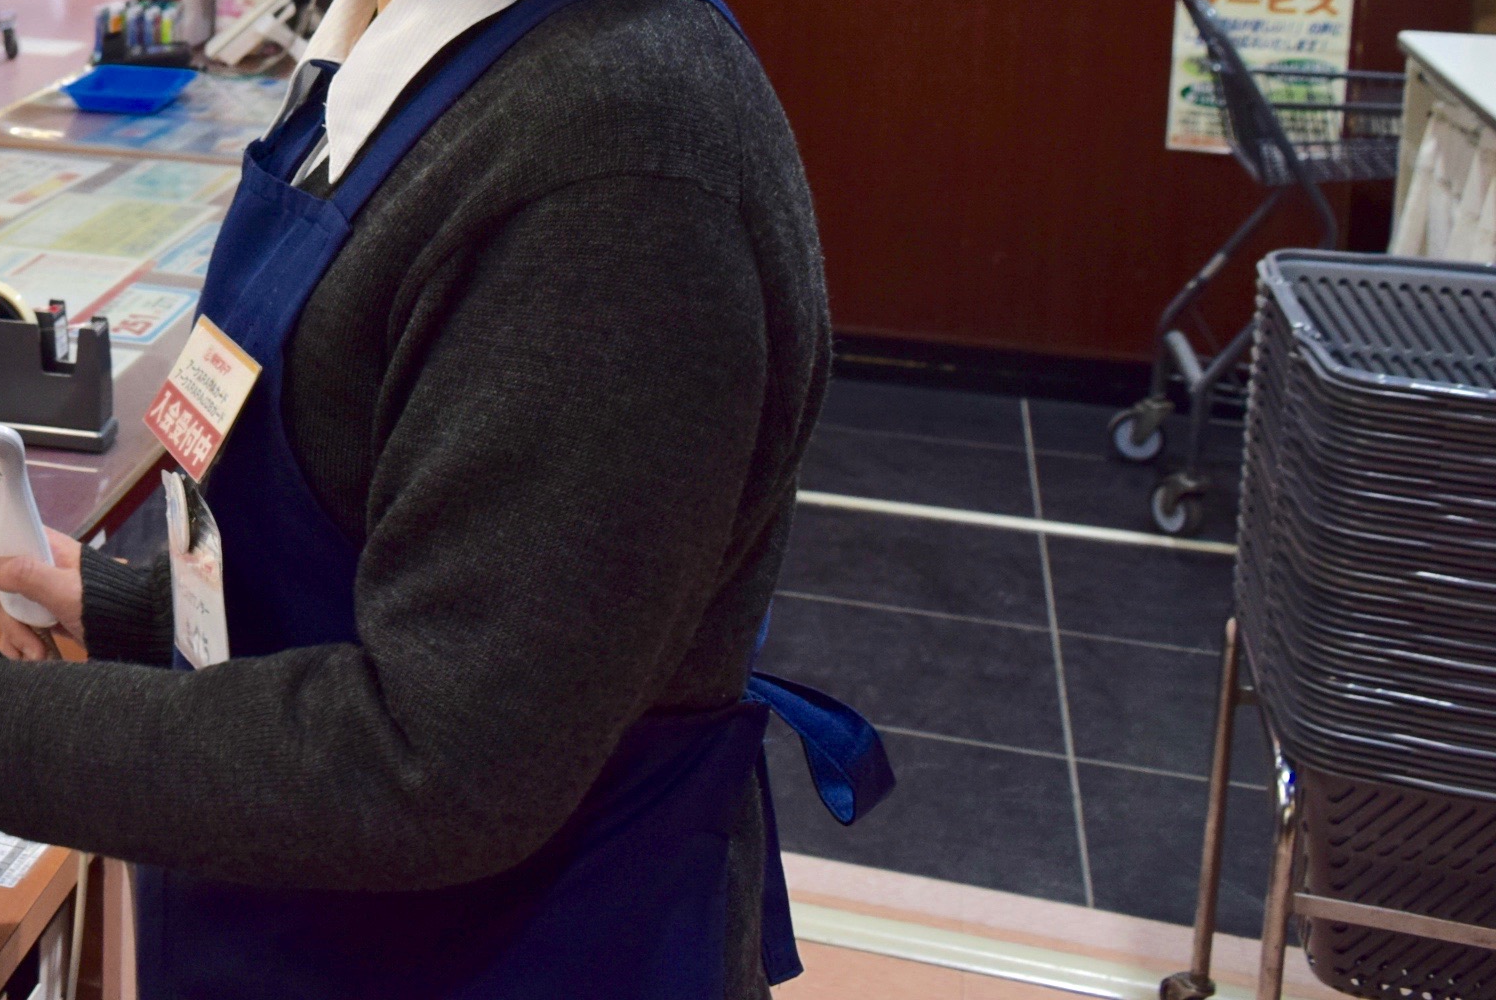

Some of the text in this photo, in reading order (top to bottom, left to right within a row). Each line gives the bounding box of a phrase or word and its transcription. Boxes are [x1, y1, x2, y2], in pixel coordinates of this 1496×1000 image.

[149, 389, 213, 467] 入会受付中
